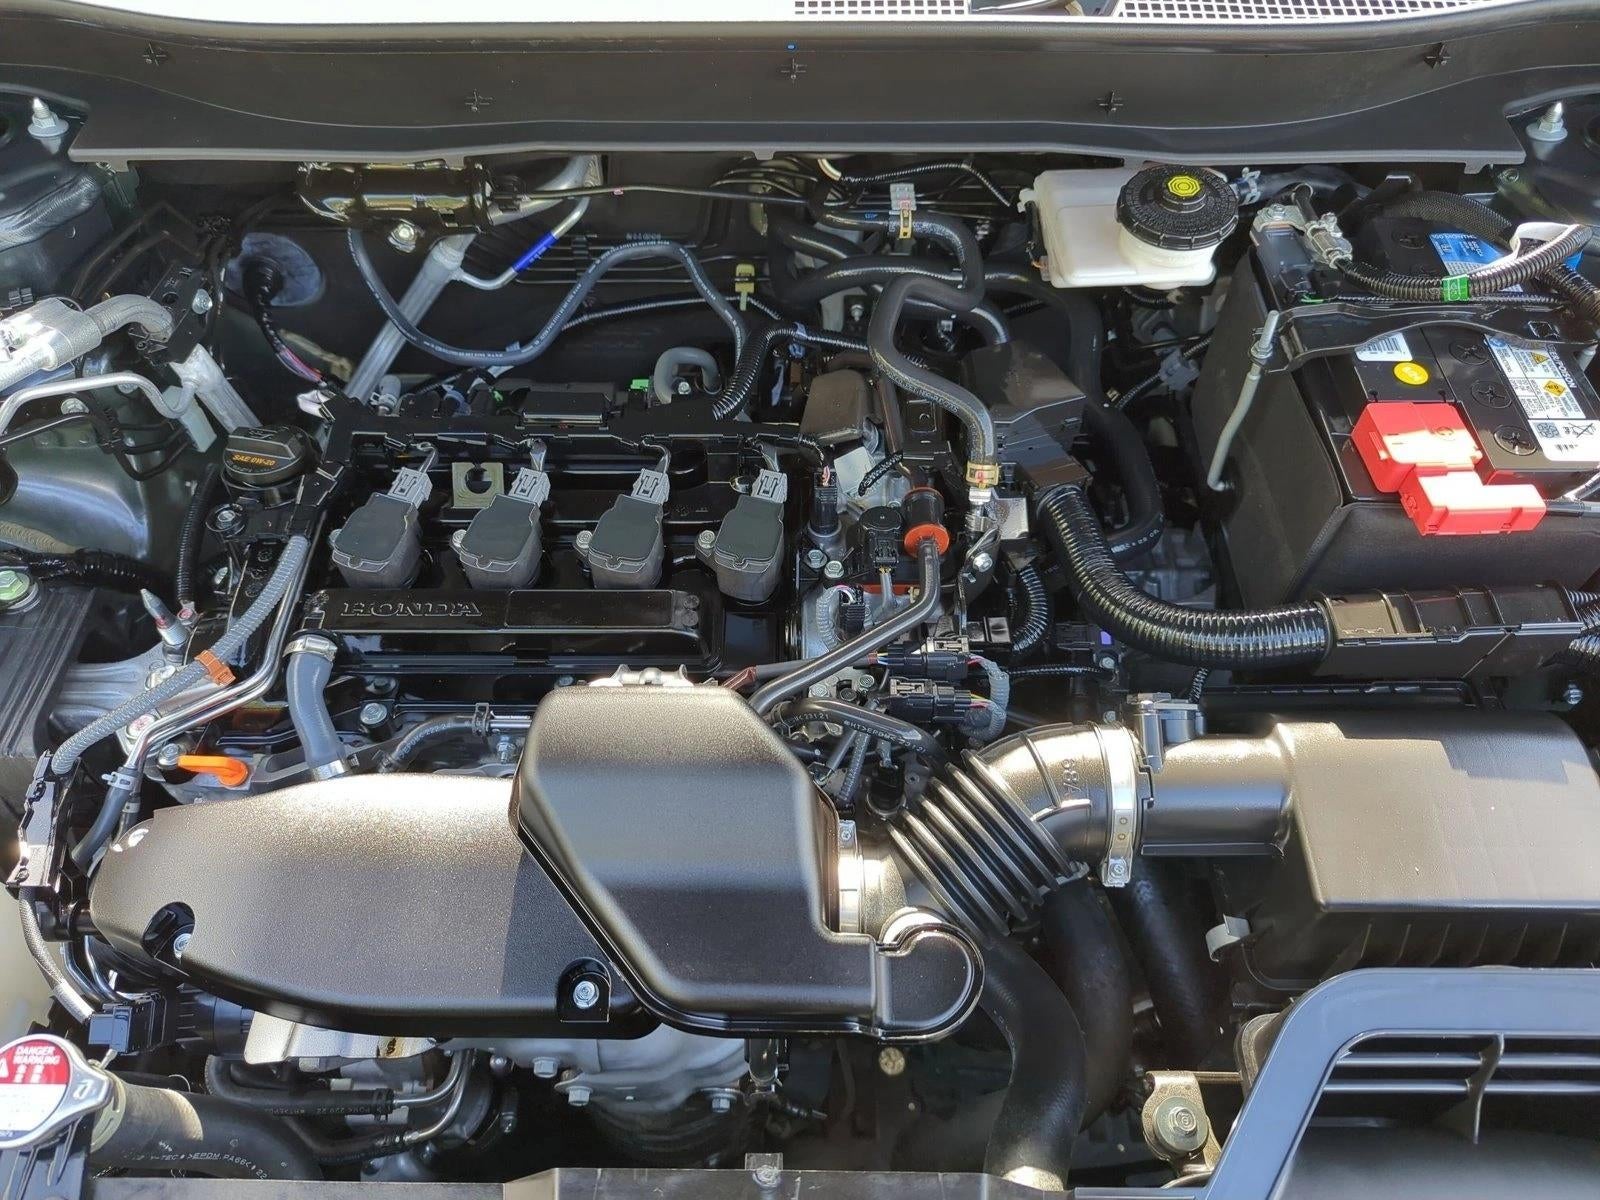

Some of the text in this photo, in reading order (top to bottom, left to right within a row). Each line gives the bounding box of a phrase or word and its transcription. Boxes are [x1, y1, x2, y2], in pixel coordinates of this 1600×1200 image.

[232, 454, 250, 462] SAE
[340, 602, 482, 617] HONDA
[15, 1046, 55, 1056] DANGER
[13, 1055, 61, 1065] WARNING
